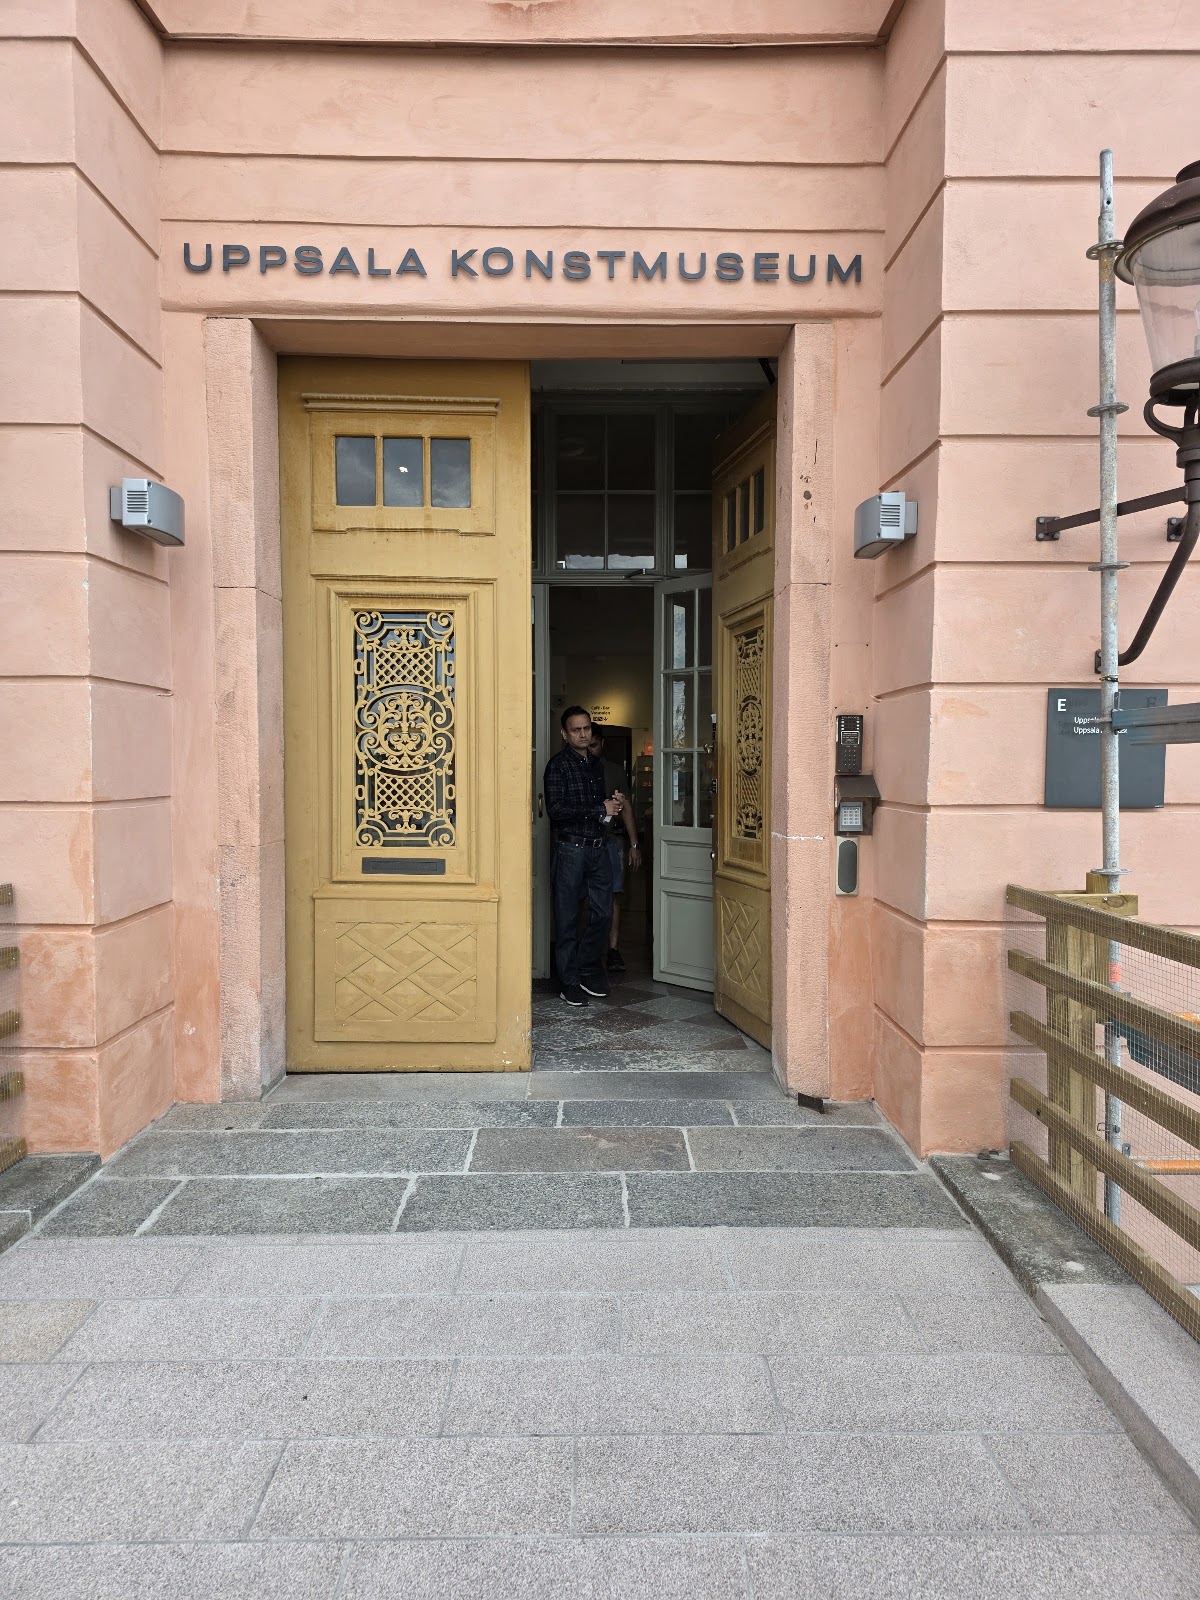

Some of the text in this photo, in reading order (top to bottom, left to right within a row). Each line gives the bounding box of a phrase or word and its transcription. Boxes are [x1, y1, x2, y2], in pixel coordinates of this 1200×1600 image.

[183, 242, 862, 284] UPPSALA KONSTMUSEUM
[1057, 698, 1067, 712] E
[1073, 726, 1100, 735] Uppsala
